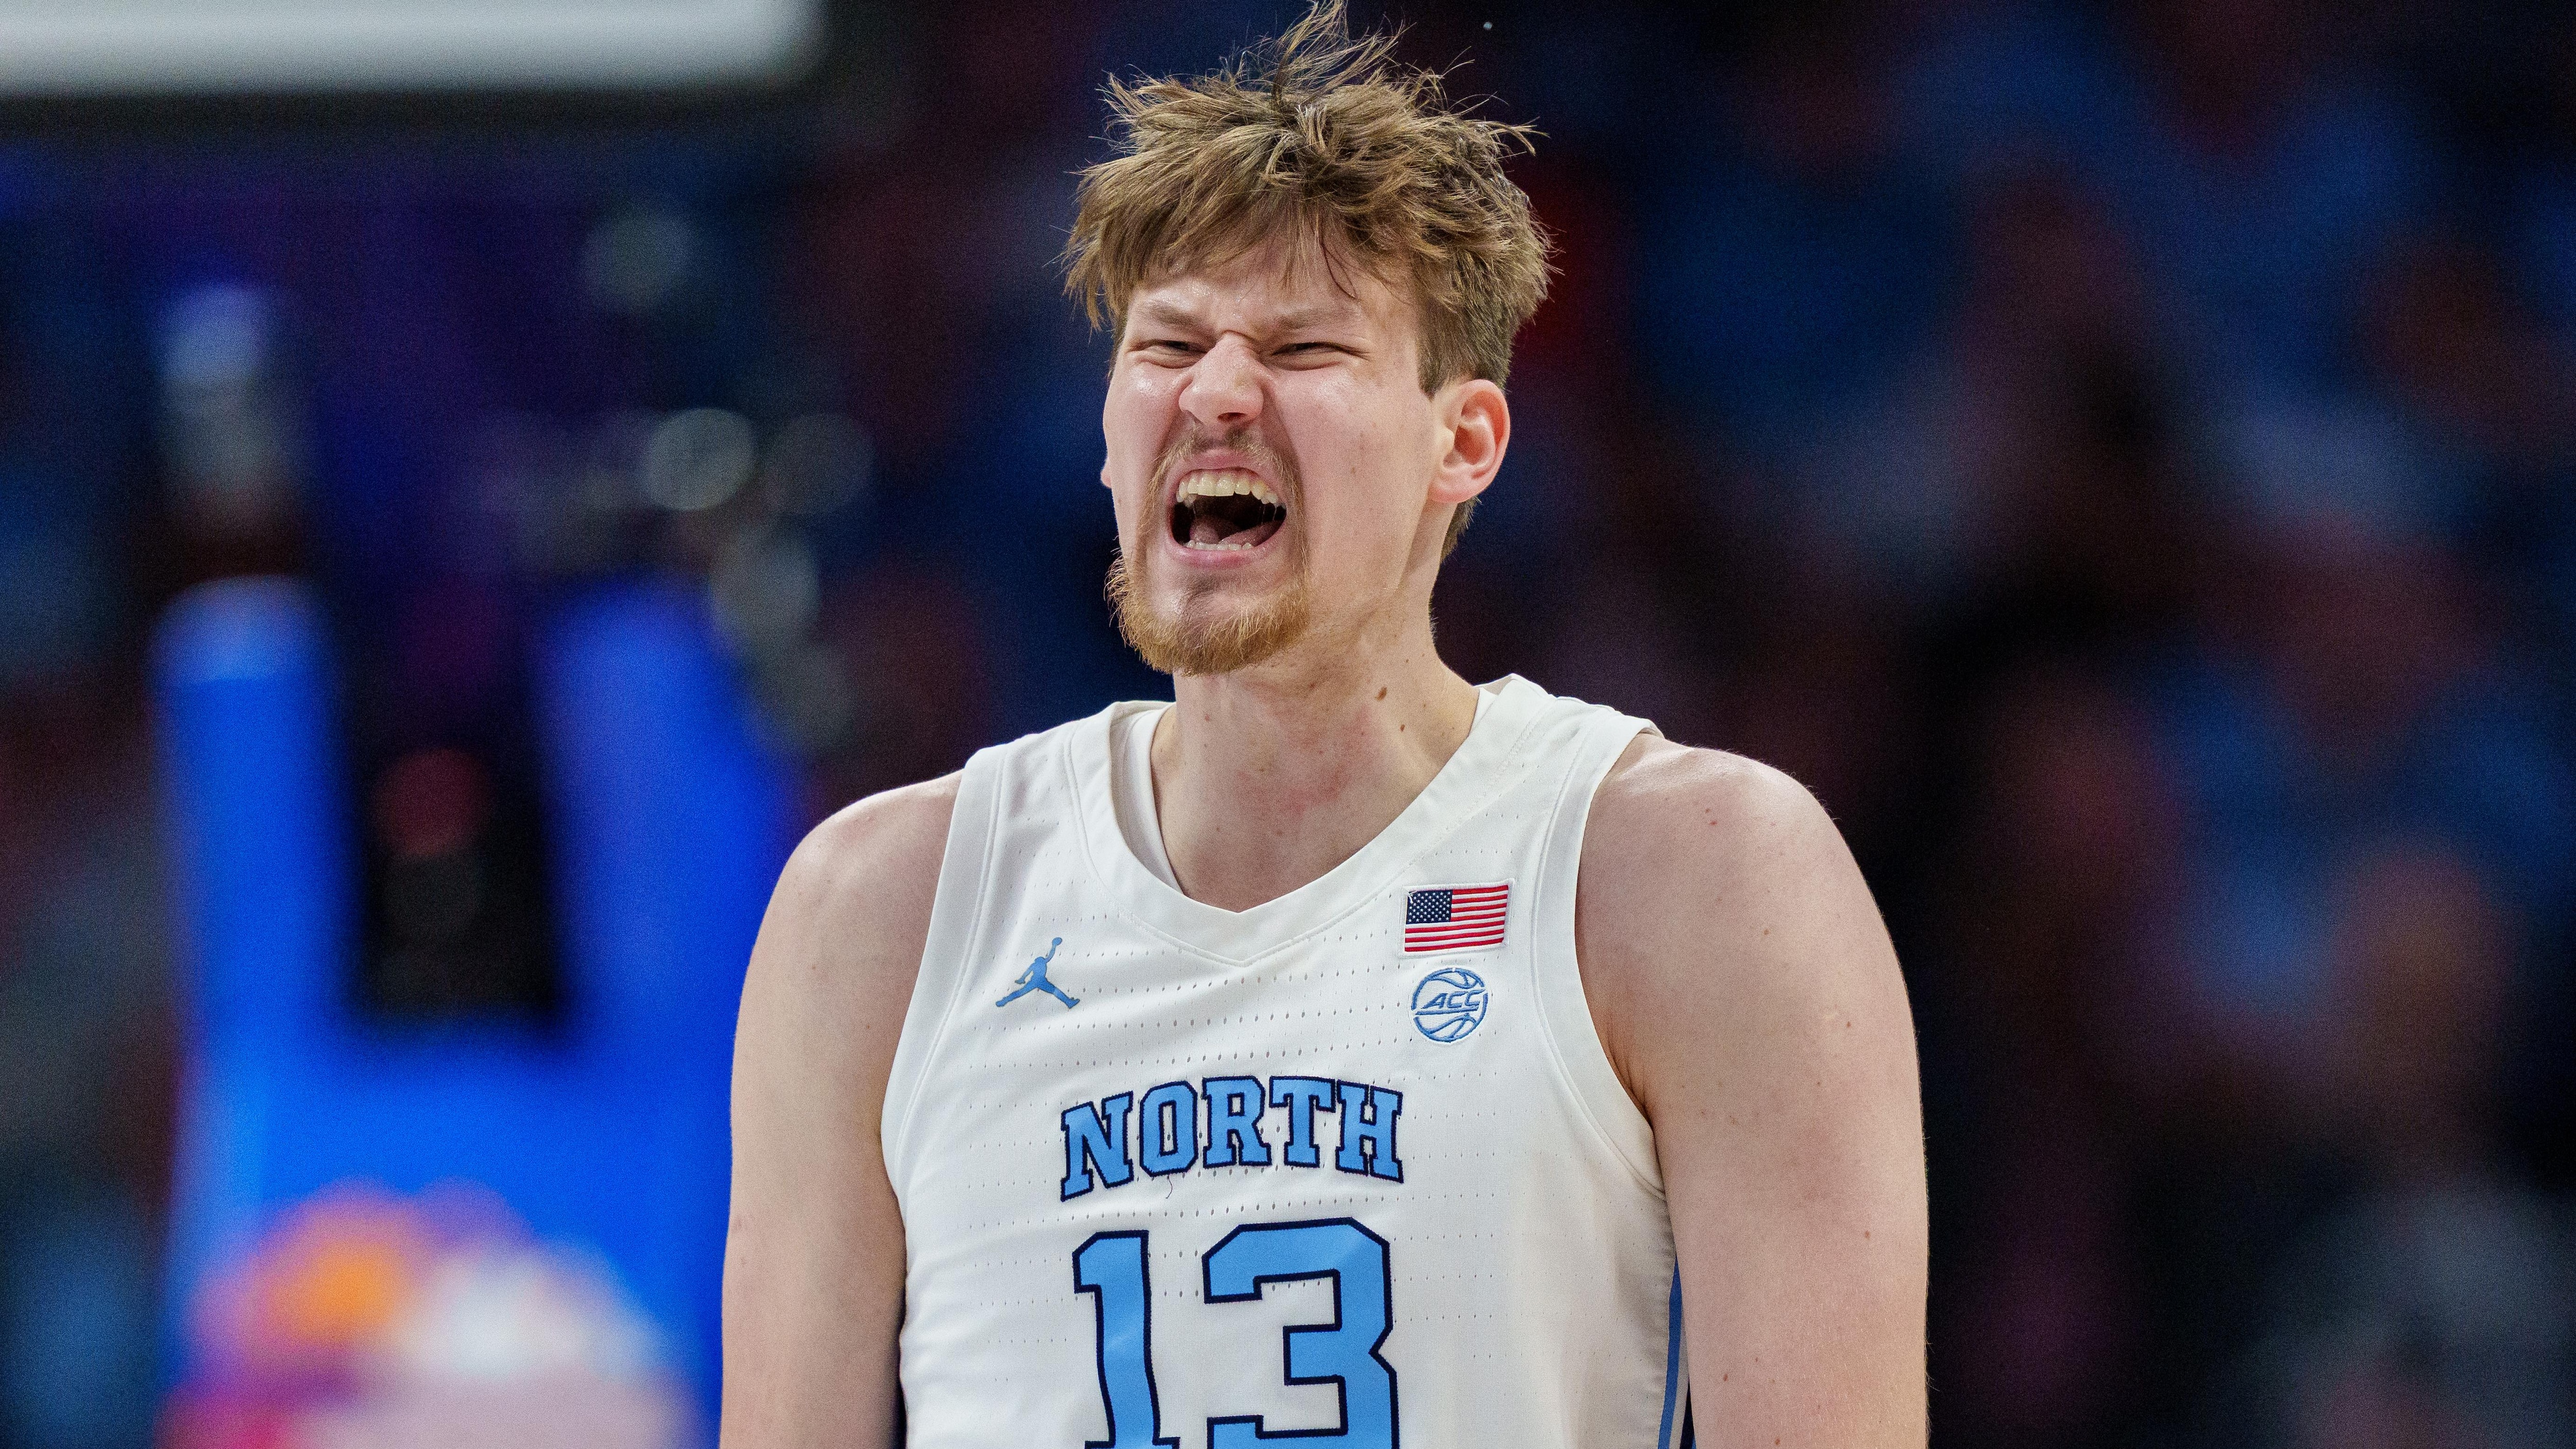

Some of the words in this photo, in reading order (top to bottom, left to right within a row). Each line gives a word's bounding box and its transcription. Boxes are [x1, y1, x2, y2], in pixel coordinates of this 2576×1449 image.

[1420, 989, 1485, 1009] ACC
[1060, 1075, 1404, 1202] NORTH
[1072, 1217, 1400, 1449] 13
